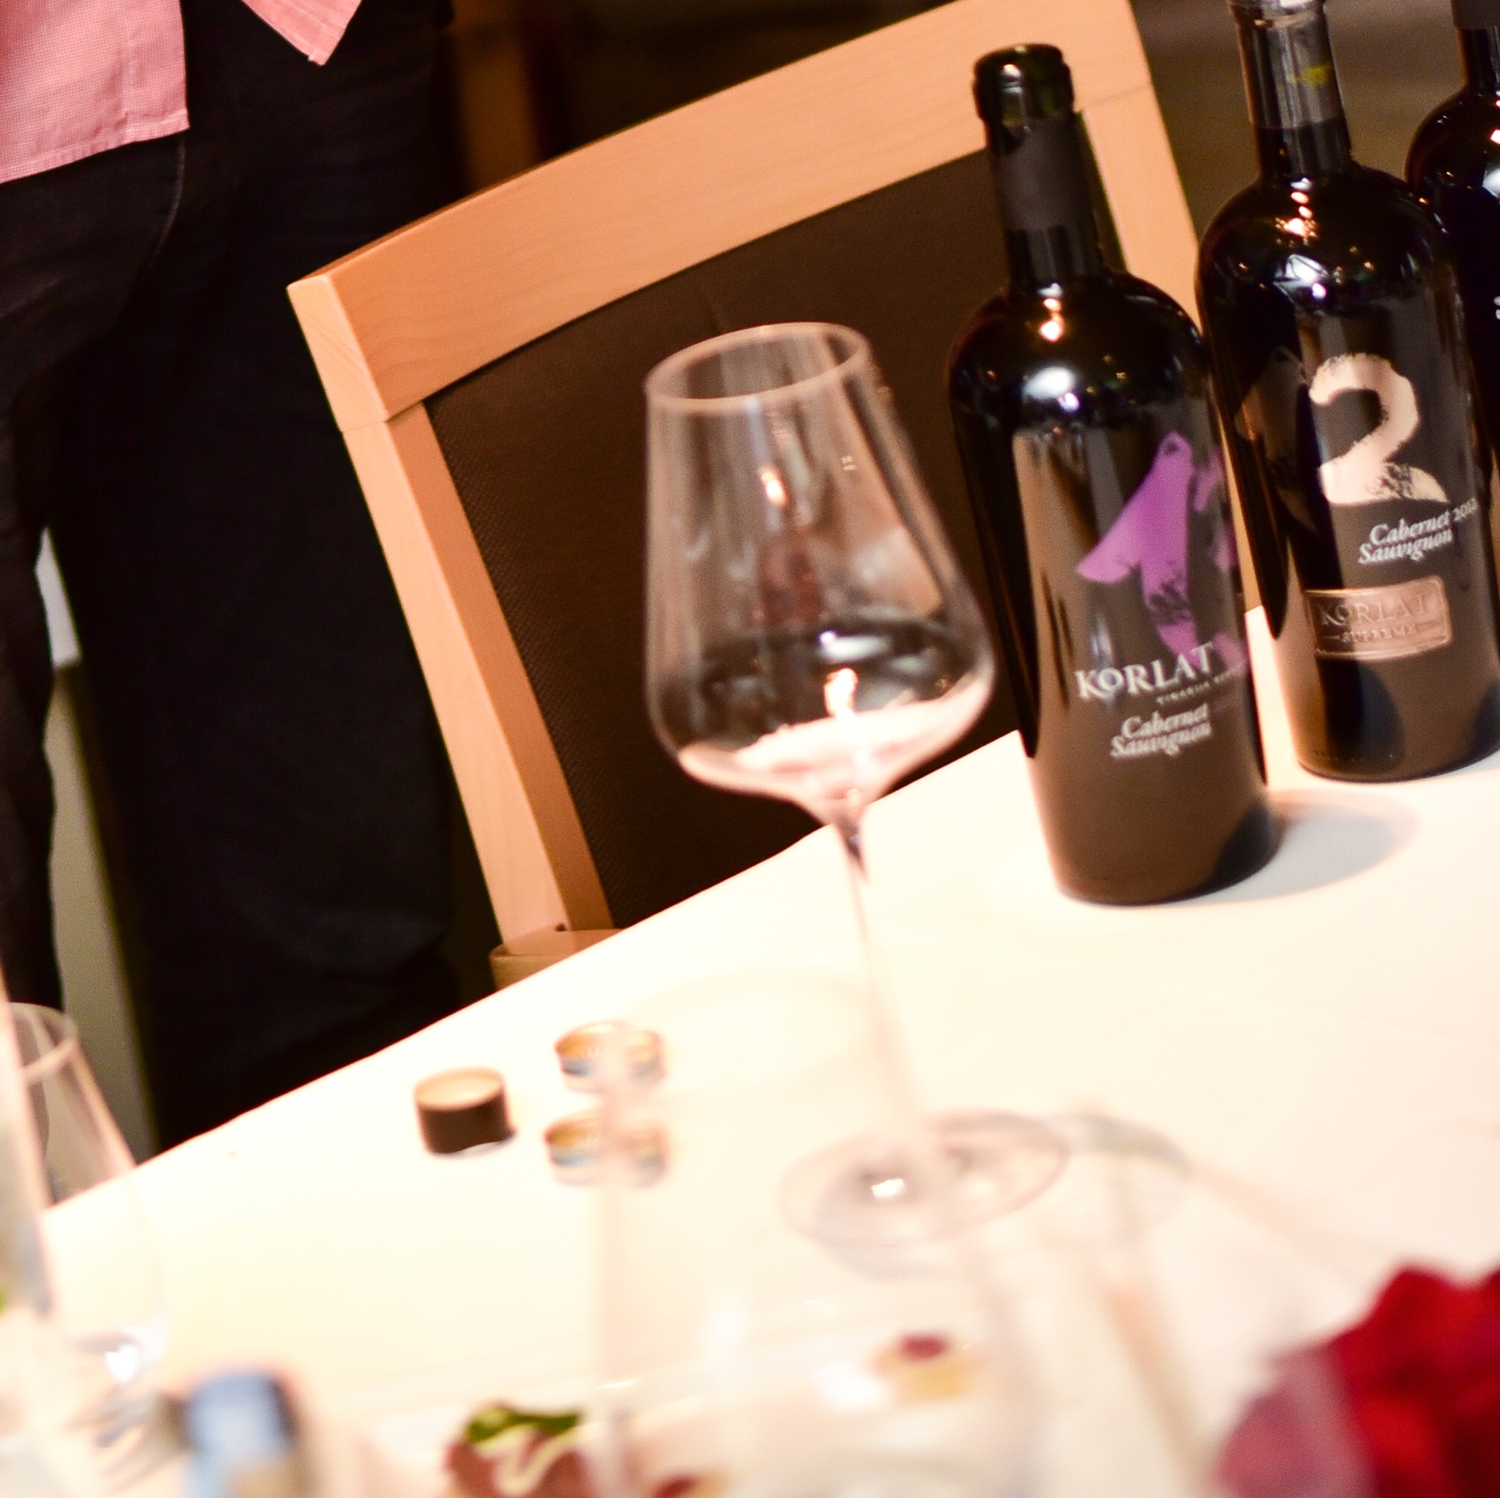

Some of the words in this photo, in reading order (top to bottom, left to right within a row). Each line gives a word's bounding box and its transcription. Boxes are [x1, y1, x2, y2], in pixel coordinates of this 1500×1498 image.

[1357, 529, 1454, 565] Sauvignon
[1369, 511, 1451, 547] Cabernet
[1318, 592, 1431, 626] KORLAT
[1074, 640, 1214, 701] KORLAT
[1120, 702, 1209, 739] Cabernet
[1109, 721, 1213, 760] Sauvignon
